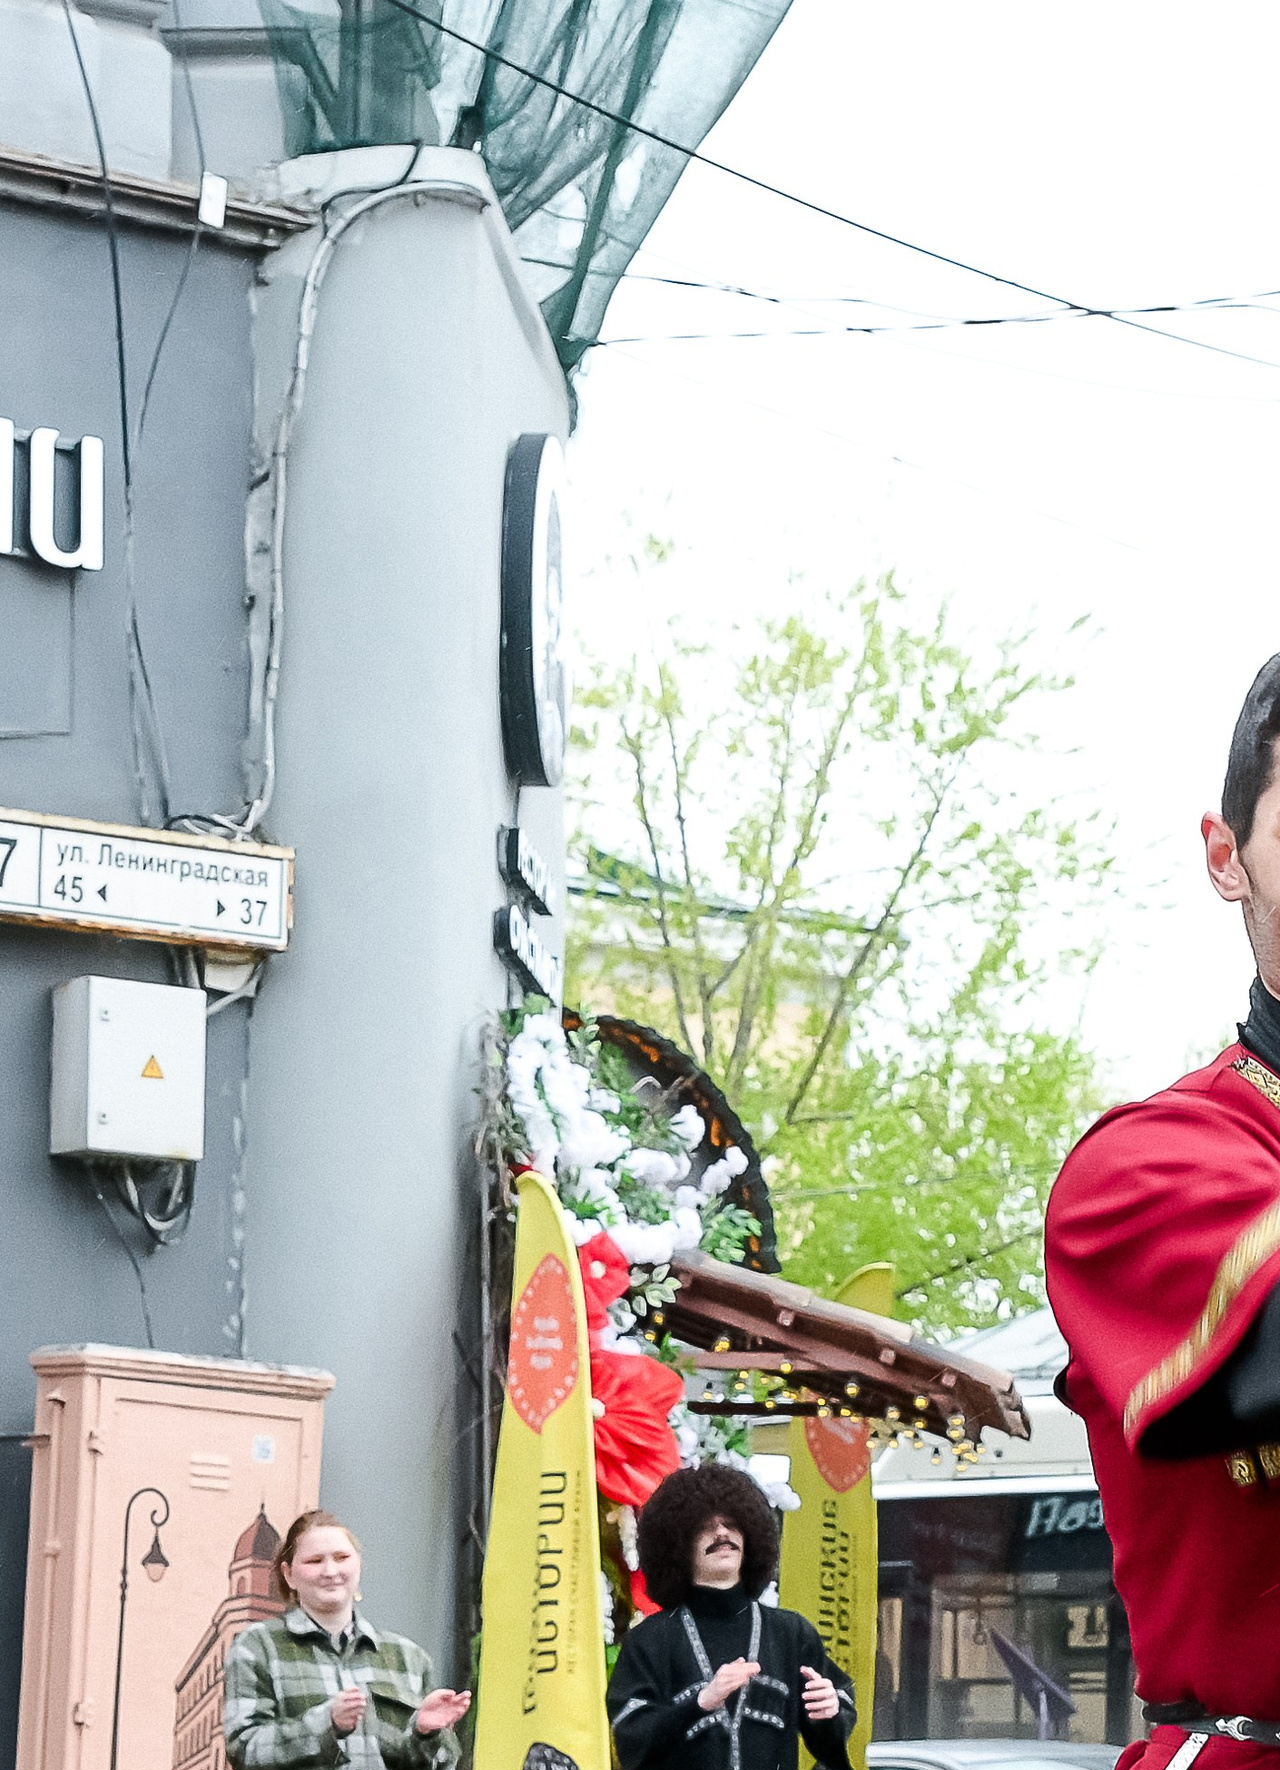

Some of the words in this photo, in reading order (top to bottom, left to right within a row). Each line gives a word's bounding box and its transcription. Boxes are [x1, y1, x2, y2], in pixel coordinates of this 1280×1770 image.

[57, 842, 89, 866] ул.
[98, 843, 269, 888] Ленинградская
[54, 874, 84, 903] 45
[240, 898, 268, 926] 37
